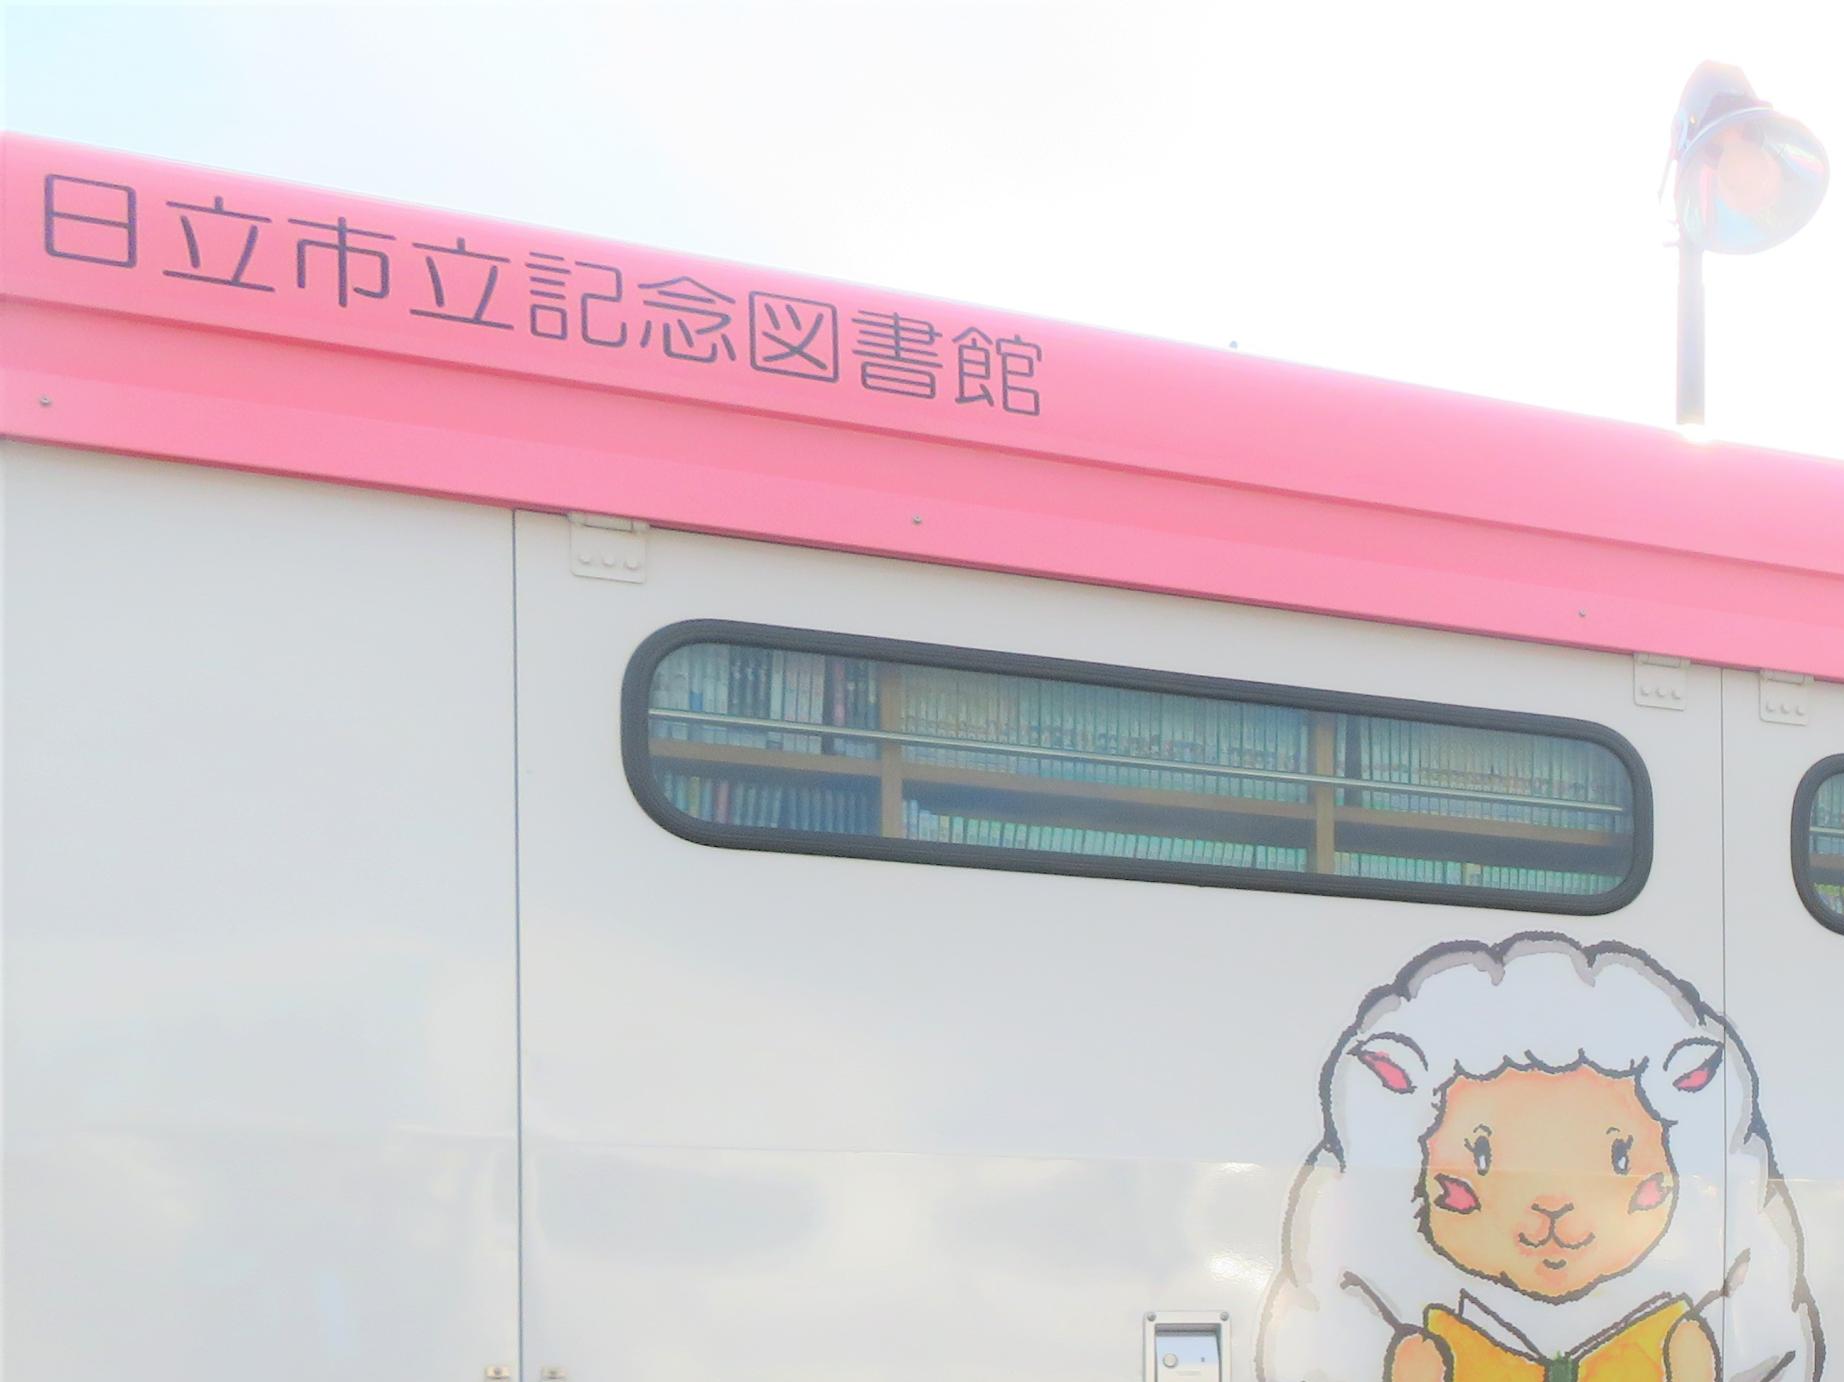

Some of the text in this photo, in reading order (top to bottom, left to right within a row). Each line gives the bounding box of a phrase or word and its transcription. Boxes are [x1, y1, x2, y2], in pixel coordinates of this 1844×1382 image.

[42, 173, 1043, 418] 日立市立記念図書館
